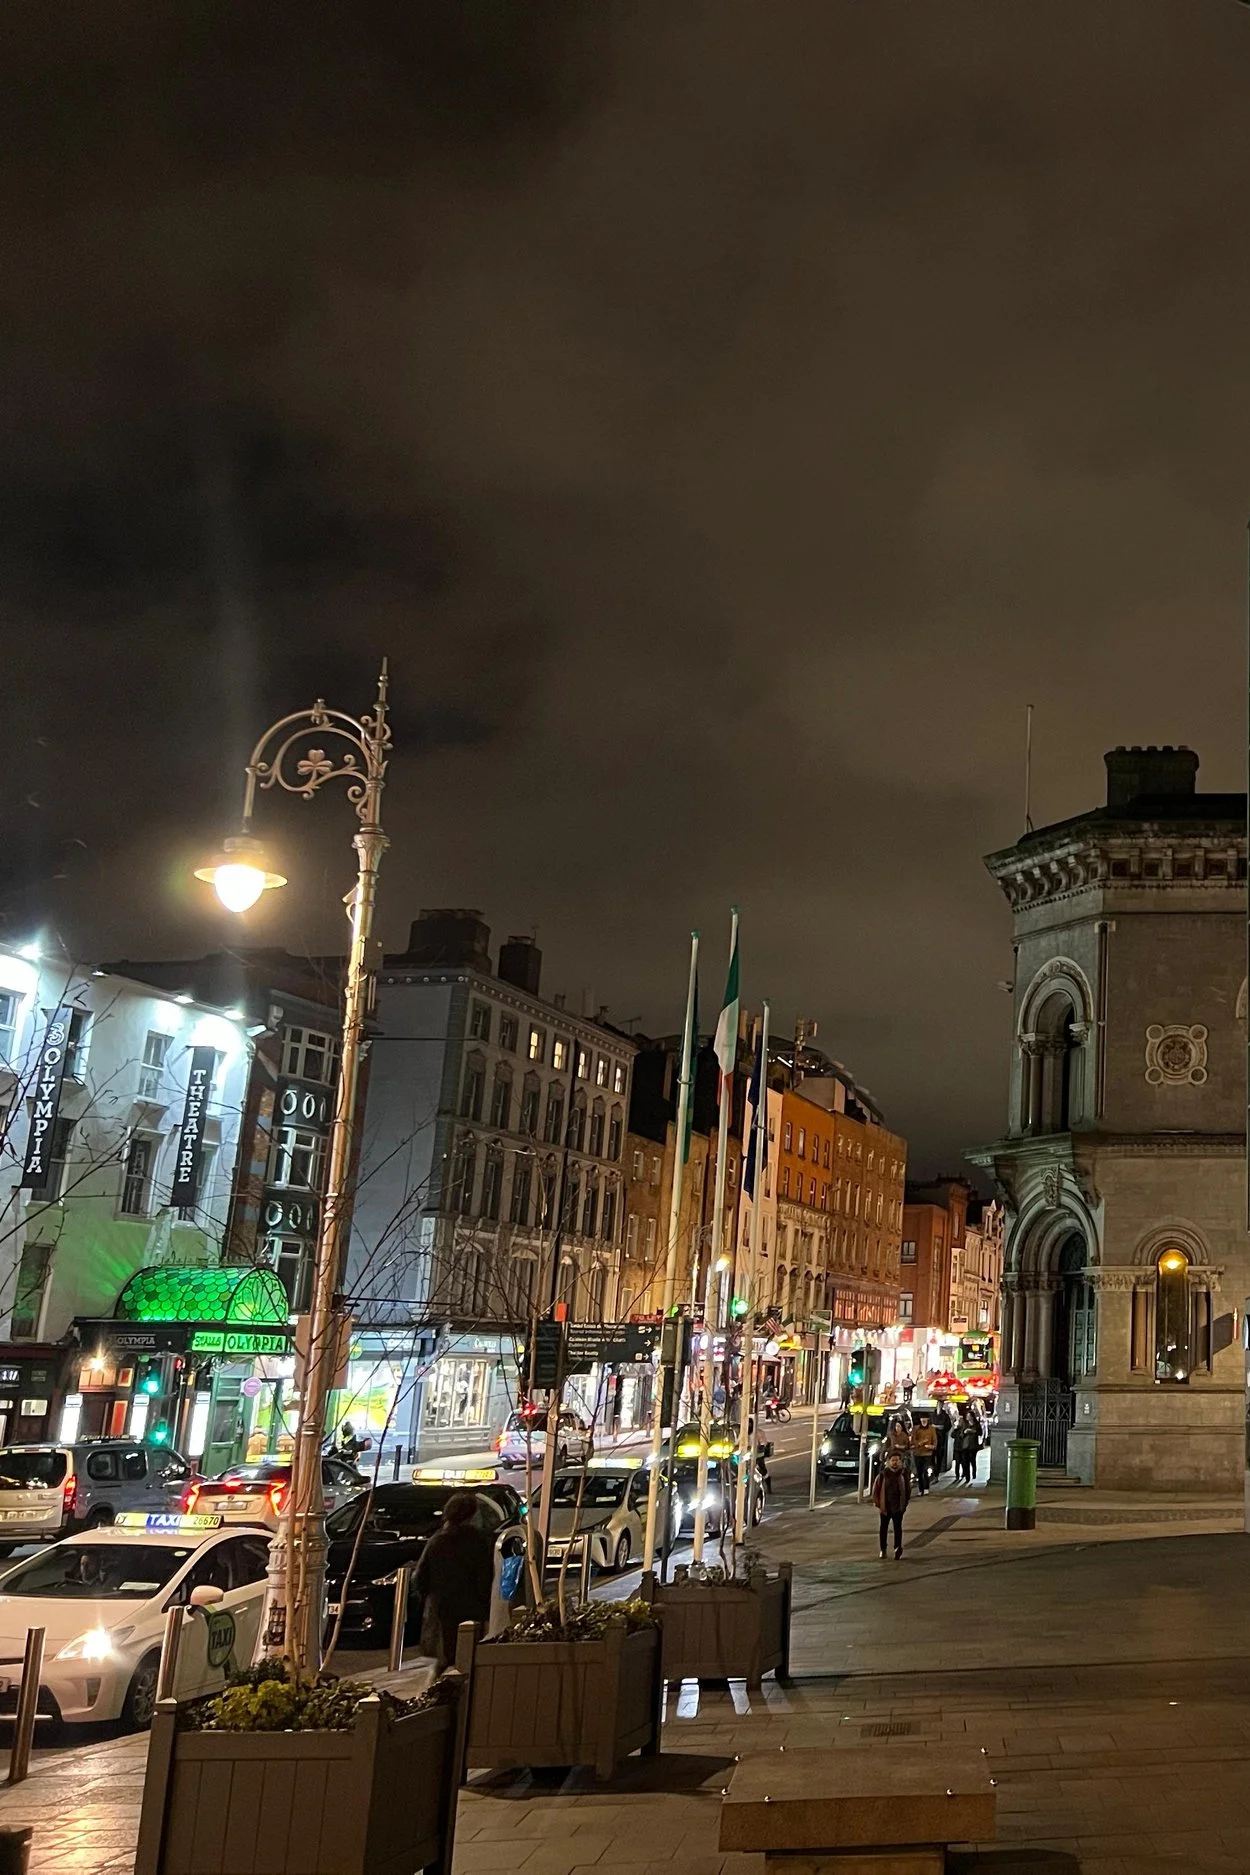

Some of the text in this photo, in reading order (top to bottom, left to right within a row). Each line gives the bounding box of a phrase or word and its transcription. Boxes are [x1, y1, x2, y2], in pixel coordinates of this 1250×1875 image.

[26, 1047, 61, 1173] OLYMPIA
[178, 1069, 207, 1182] THEATRE
[116, 1336, 156, 1345] OLYMPIA
[150, 1514, 180, 1526] TAXI
[210, 1628, 233, 1650] TAXI
